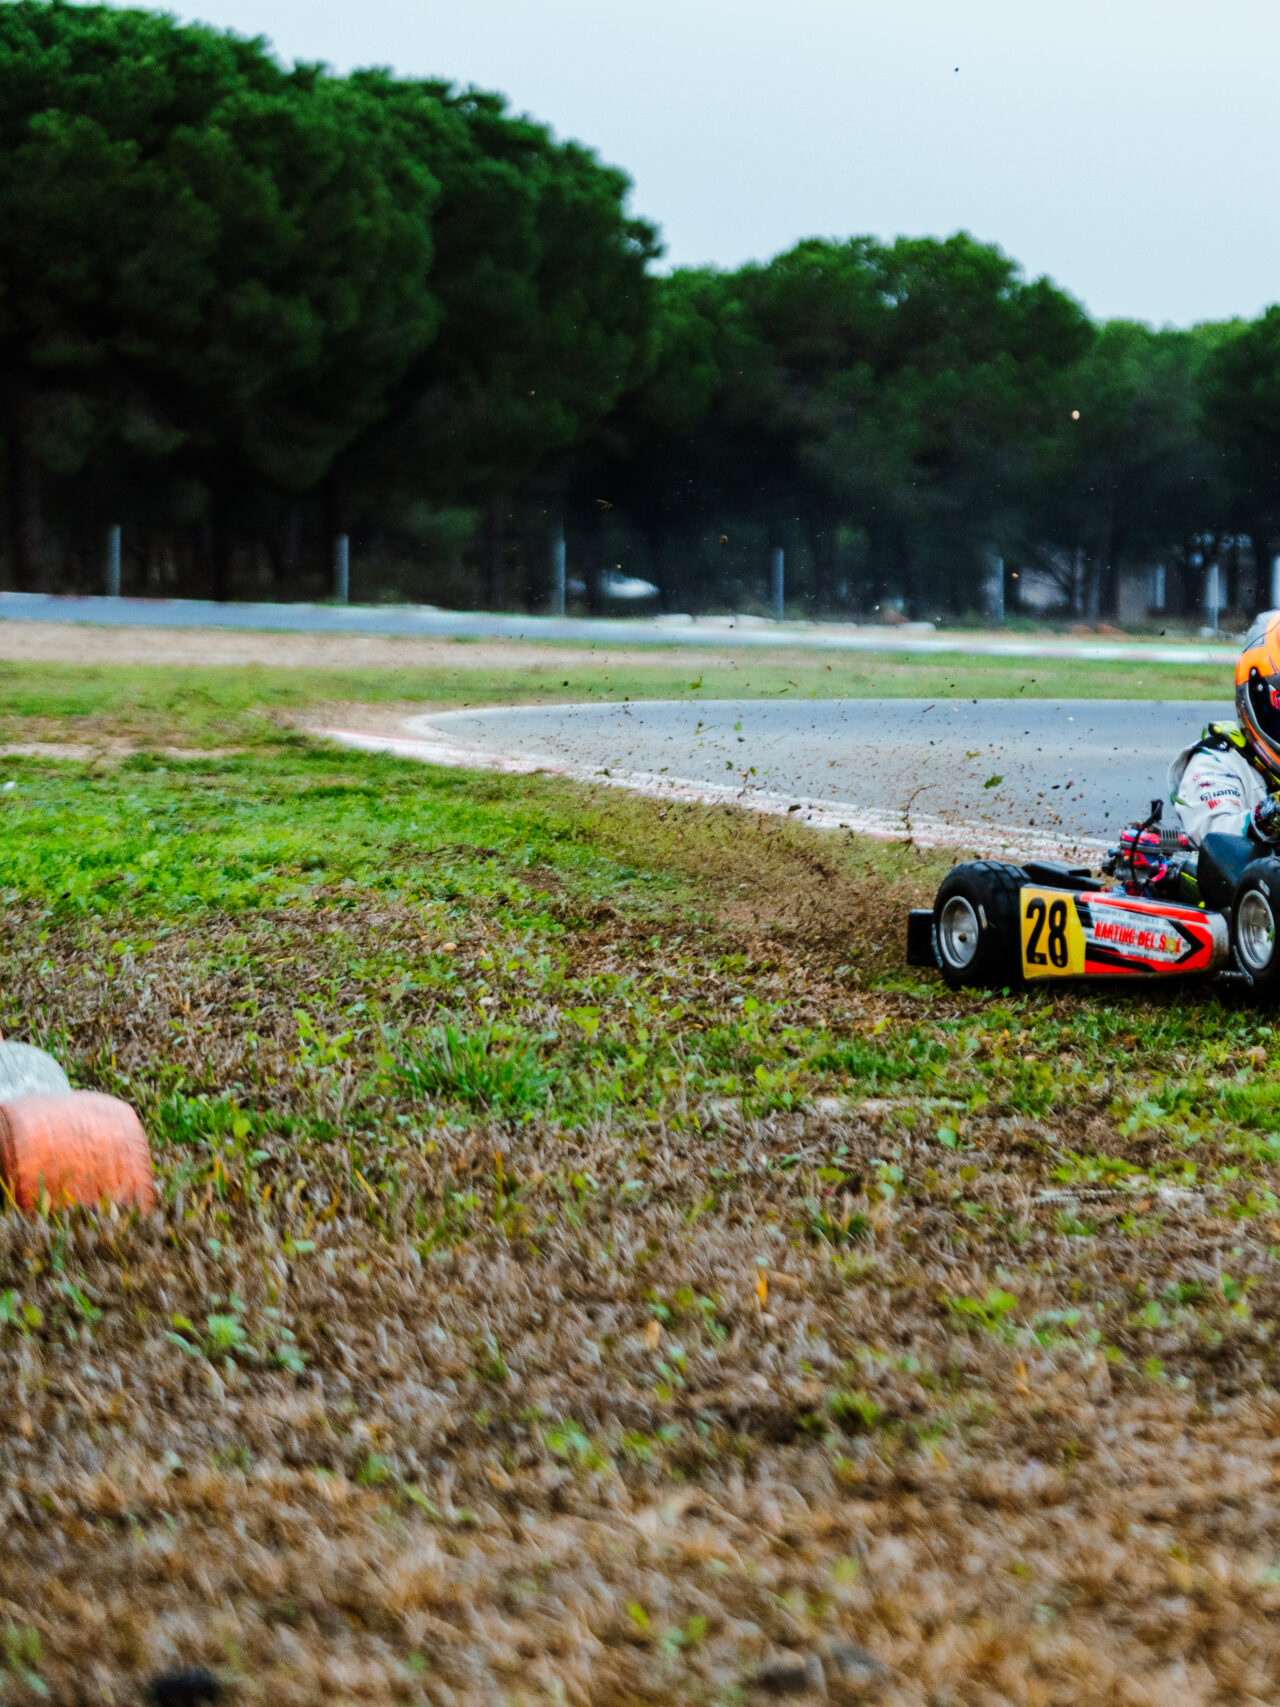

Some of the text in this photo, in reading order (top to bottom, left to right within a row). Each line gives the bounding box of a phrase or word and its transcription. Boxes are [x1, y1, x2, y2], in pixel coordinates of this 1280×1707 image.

[1026, 897, 1069, 968] 28
[1094, 921, 1135, 945] KARTING
[1137, 930, 1155, 950] DEL
